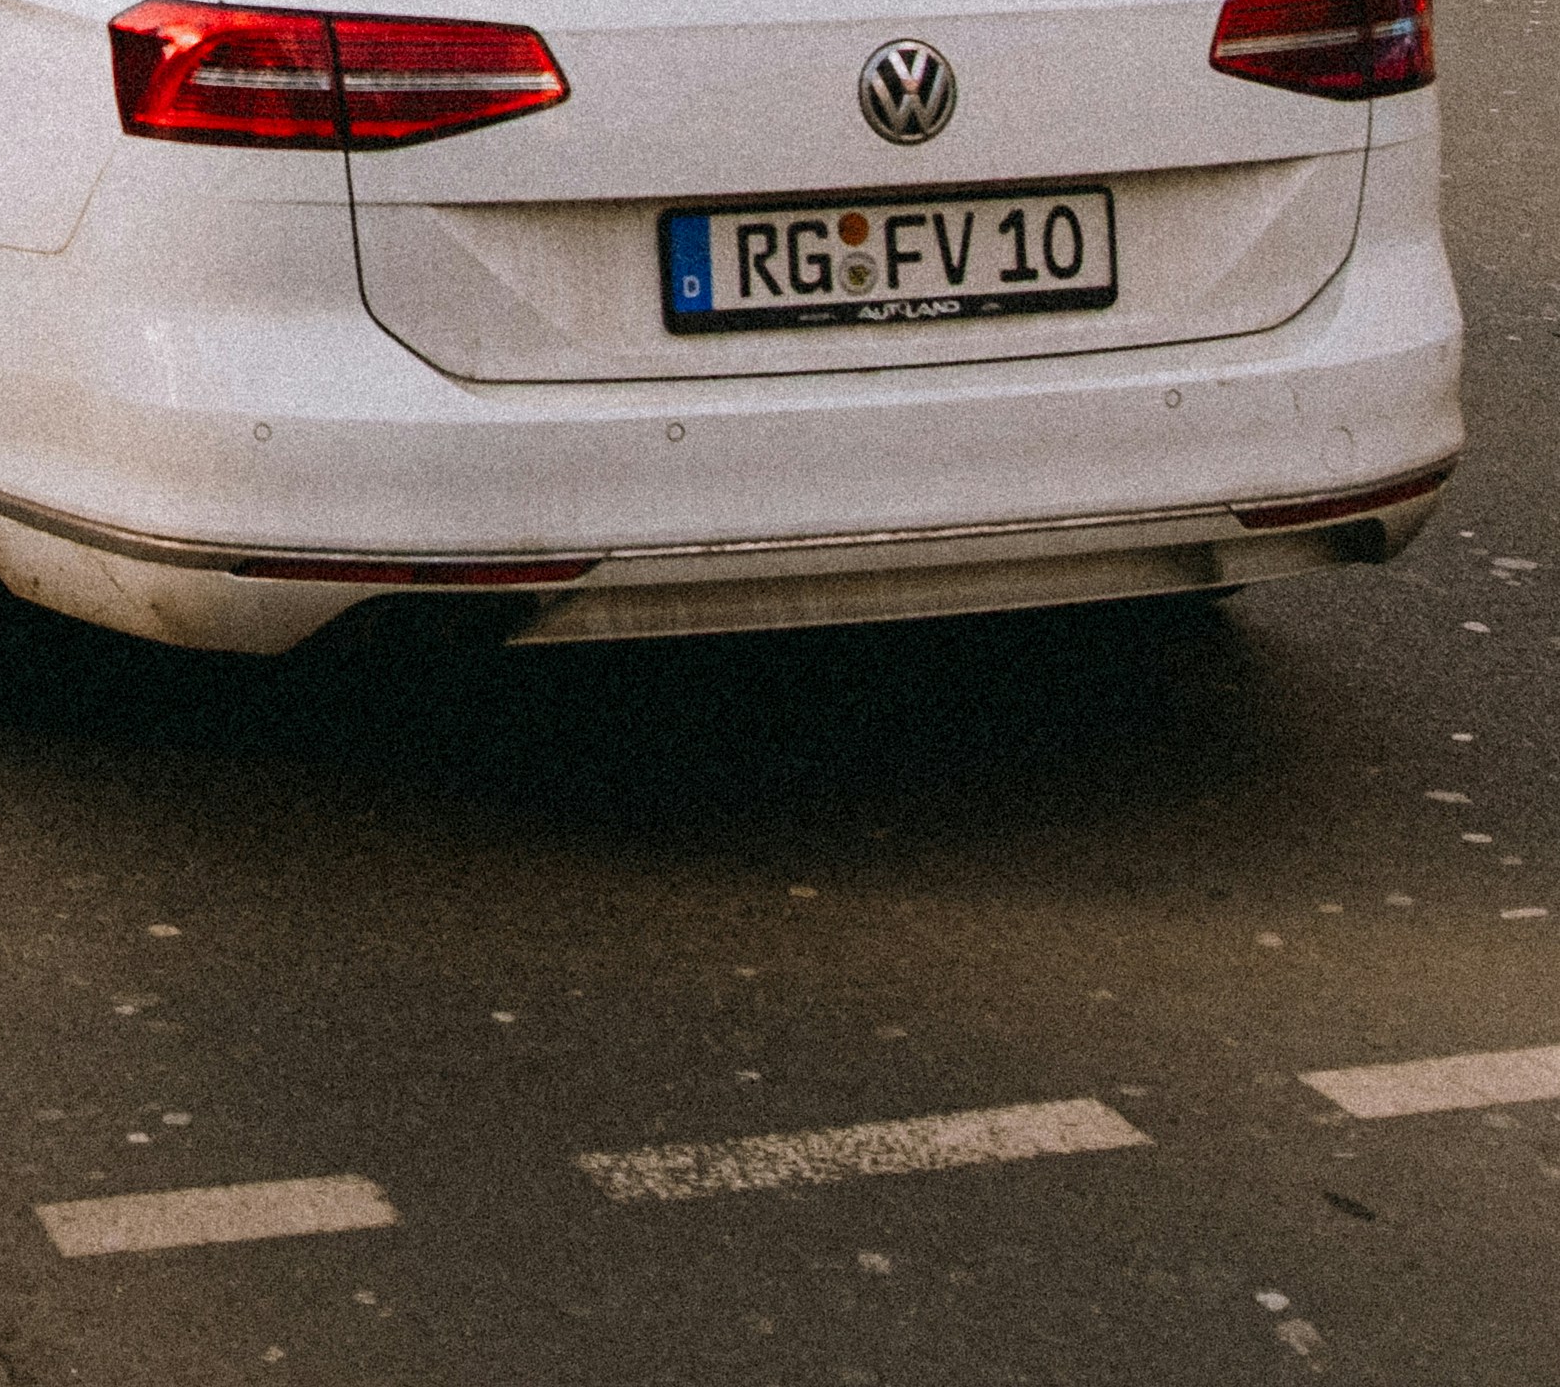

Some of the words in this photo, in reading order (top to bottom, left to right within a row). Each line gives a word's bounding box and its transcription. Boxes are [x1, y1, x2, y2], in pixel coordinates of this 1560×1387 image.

[737, 220, 832, 298] RG
[885, 211, 975, 289] FV
[999, 205, 1084, 283] 10
